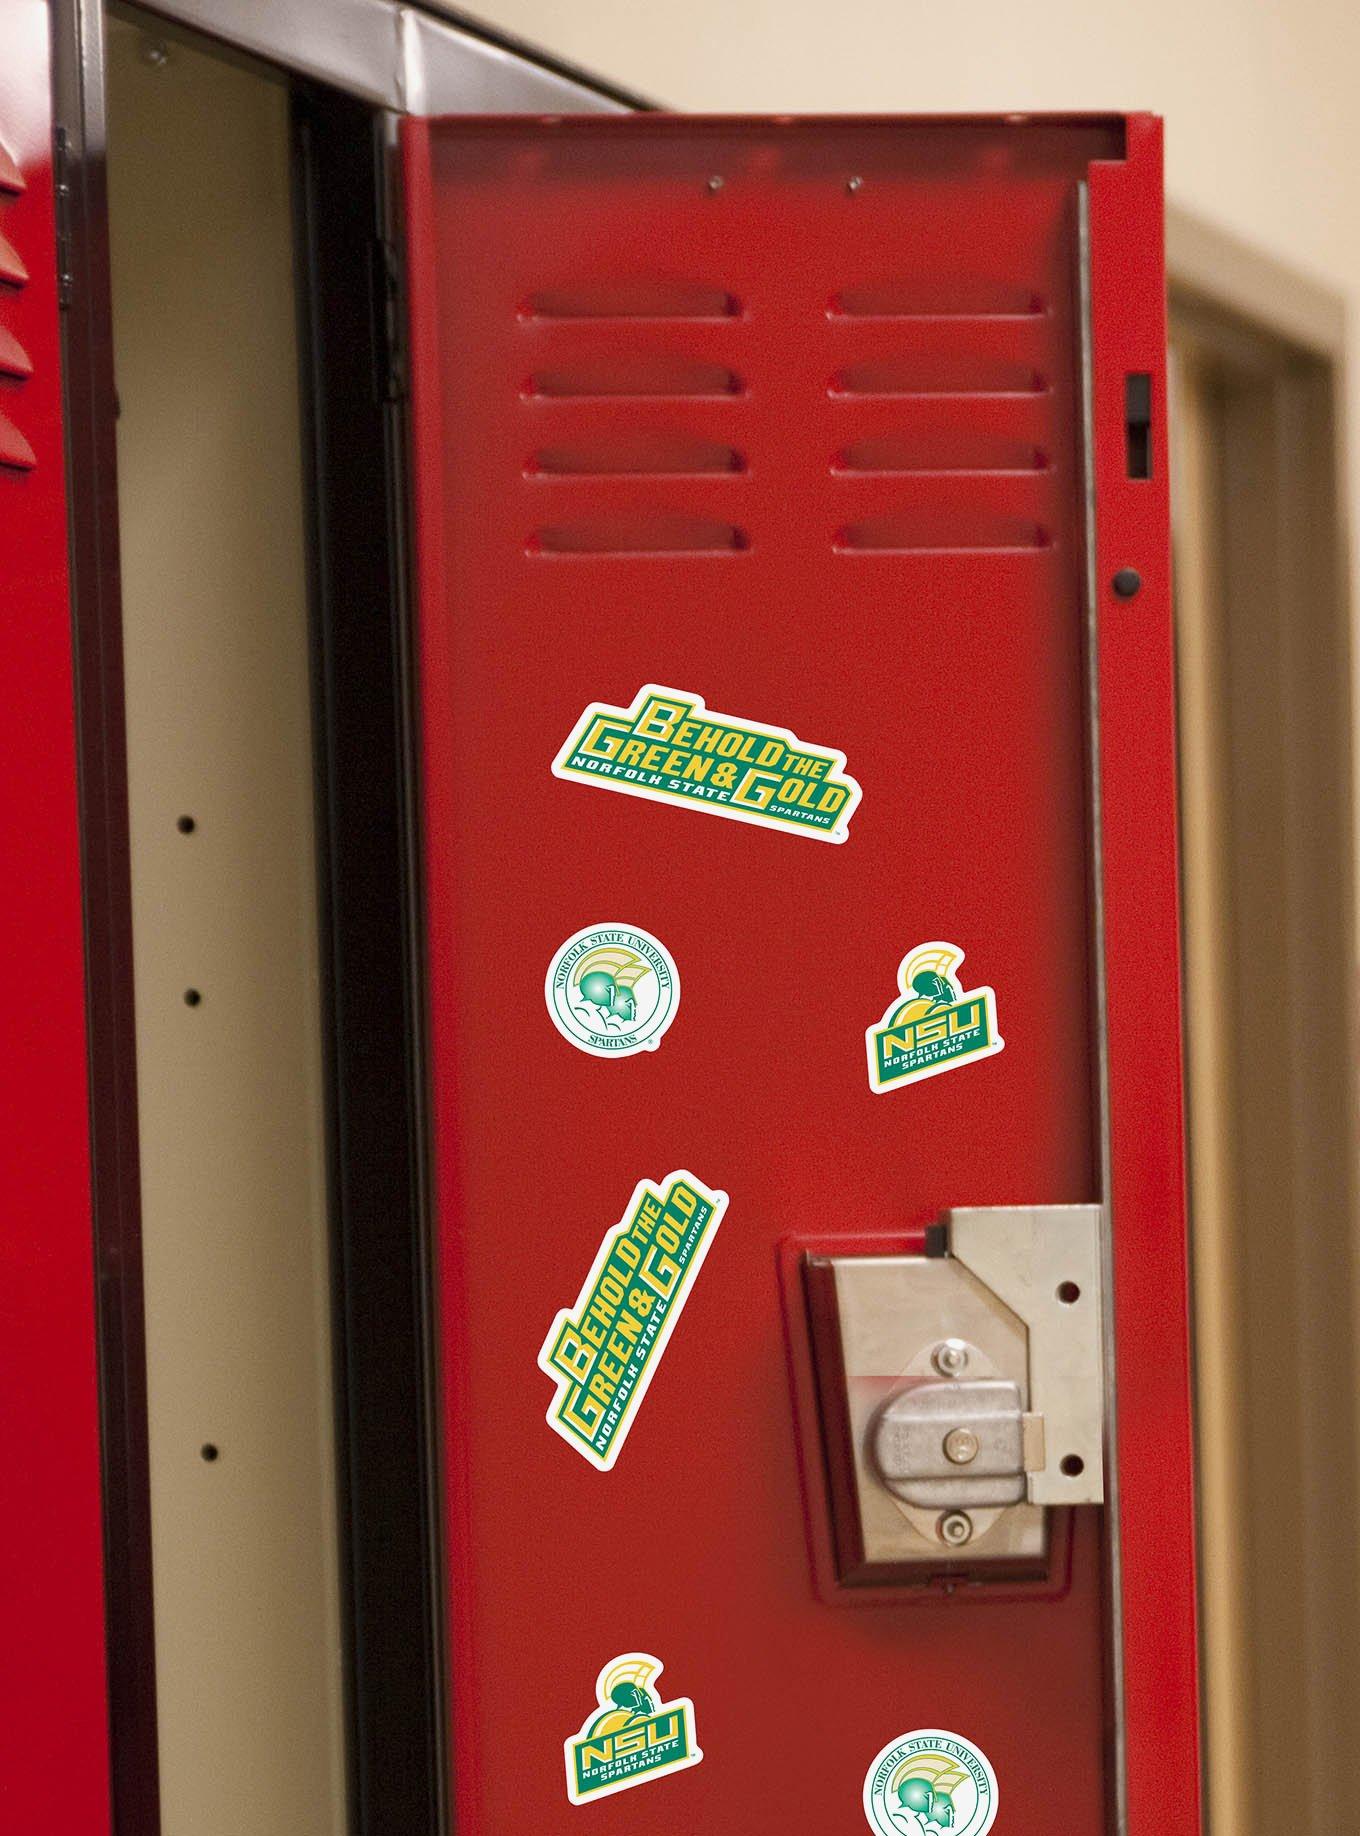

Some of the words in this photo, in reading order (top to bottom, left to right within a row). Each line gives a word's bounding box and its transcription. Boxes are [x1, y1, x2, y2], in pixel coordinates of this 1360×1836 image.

[577, 718, 712, 786] GREEN
[709, 762, 739, 789] &
[729, 767, 845, 814] GOLD
[632, 699, 785, 768] BEHOLD
[781, 754, 829, 779] THE
[570, 755, 662, 786] NORFOLK
[667, 778, 731, 802] STATE
[768, 803, 831, 825] SPARTANS
[555, 940, 589, 990] NORFOLK
[590, 932, 625, 946] STATE
[627, 935, 670, 990] UNIVERSITY
[587, 1033, 638, 1048] SPARTANS
[882, 1003, 981, 1060] NSU
[883, 1043, 939, 1069] NORFOLK
[942, 1028, 981, 1047] STATE
[901, 1042, 964, 1070] SPARTANS
[637, 1185, 699, 1302] GOLD
[677, 1205, 708, 1265] SPARTANS
[553, 1237, 643, 1386] BEHOLD
[631, 1196, 662, 1247] THE
[627, 1286, 657, 1318] &
[562, 1309, 645, 1442] GREEN
[595, 1363, 640, 1451] NORFOLK
[635, 1299, 668, 1361] STATE
[581, 1713, 680, 1771] NSU
[582, 1754, 638, 1780] NORFOLK
[641, 1739, 680, 1758] STATE
[600, 1753, 662, 1782] SPARTANS
[873, 1747, 907, 1796] NORFOLK
[907, 1739, 943, 1753] STATE
[945, 1741, 988, 1796] UNIVERSITY
